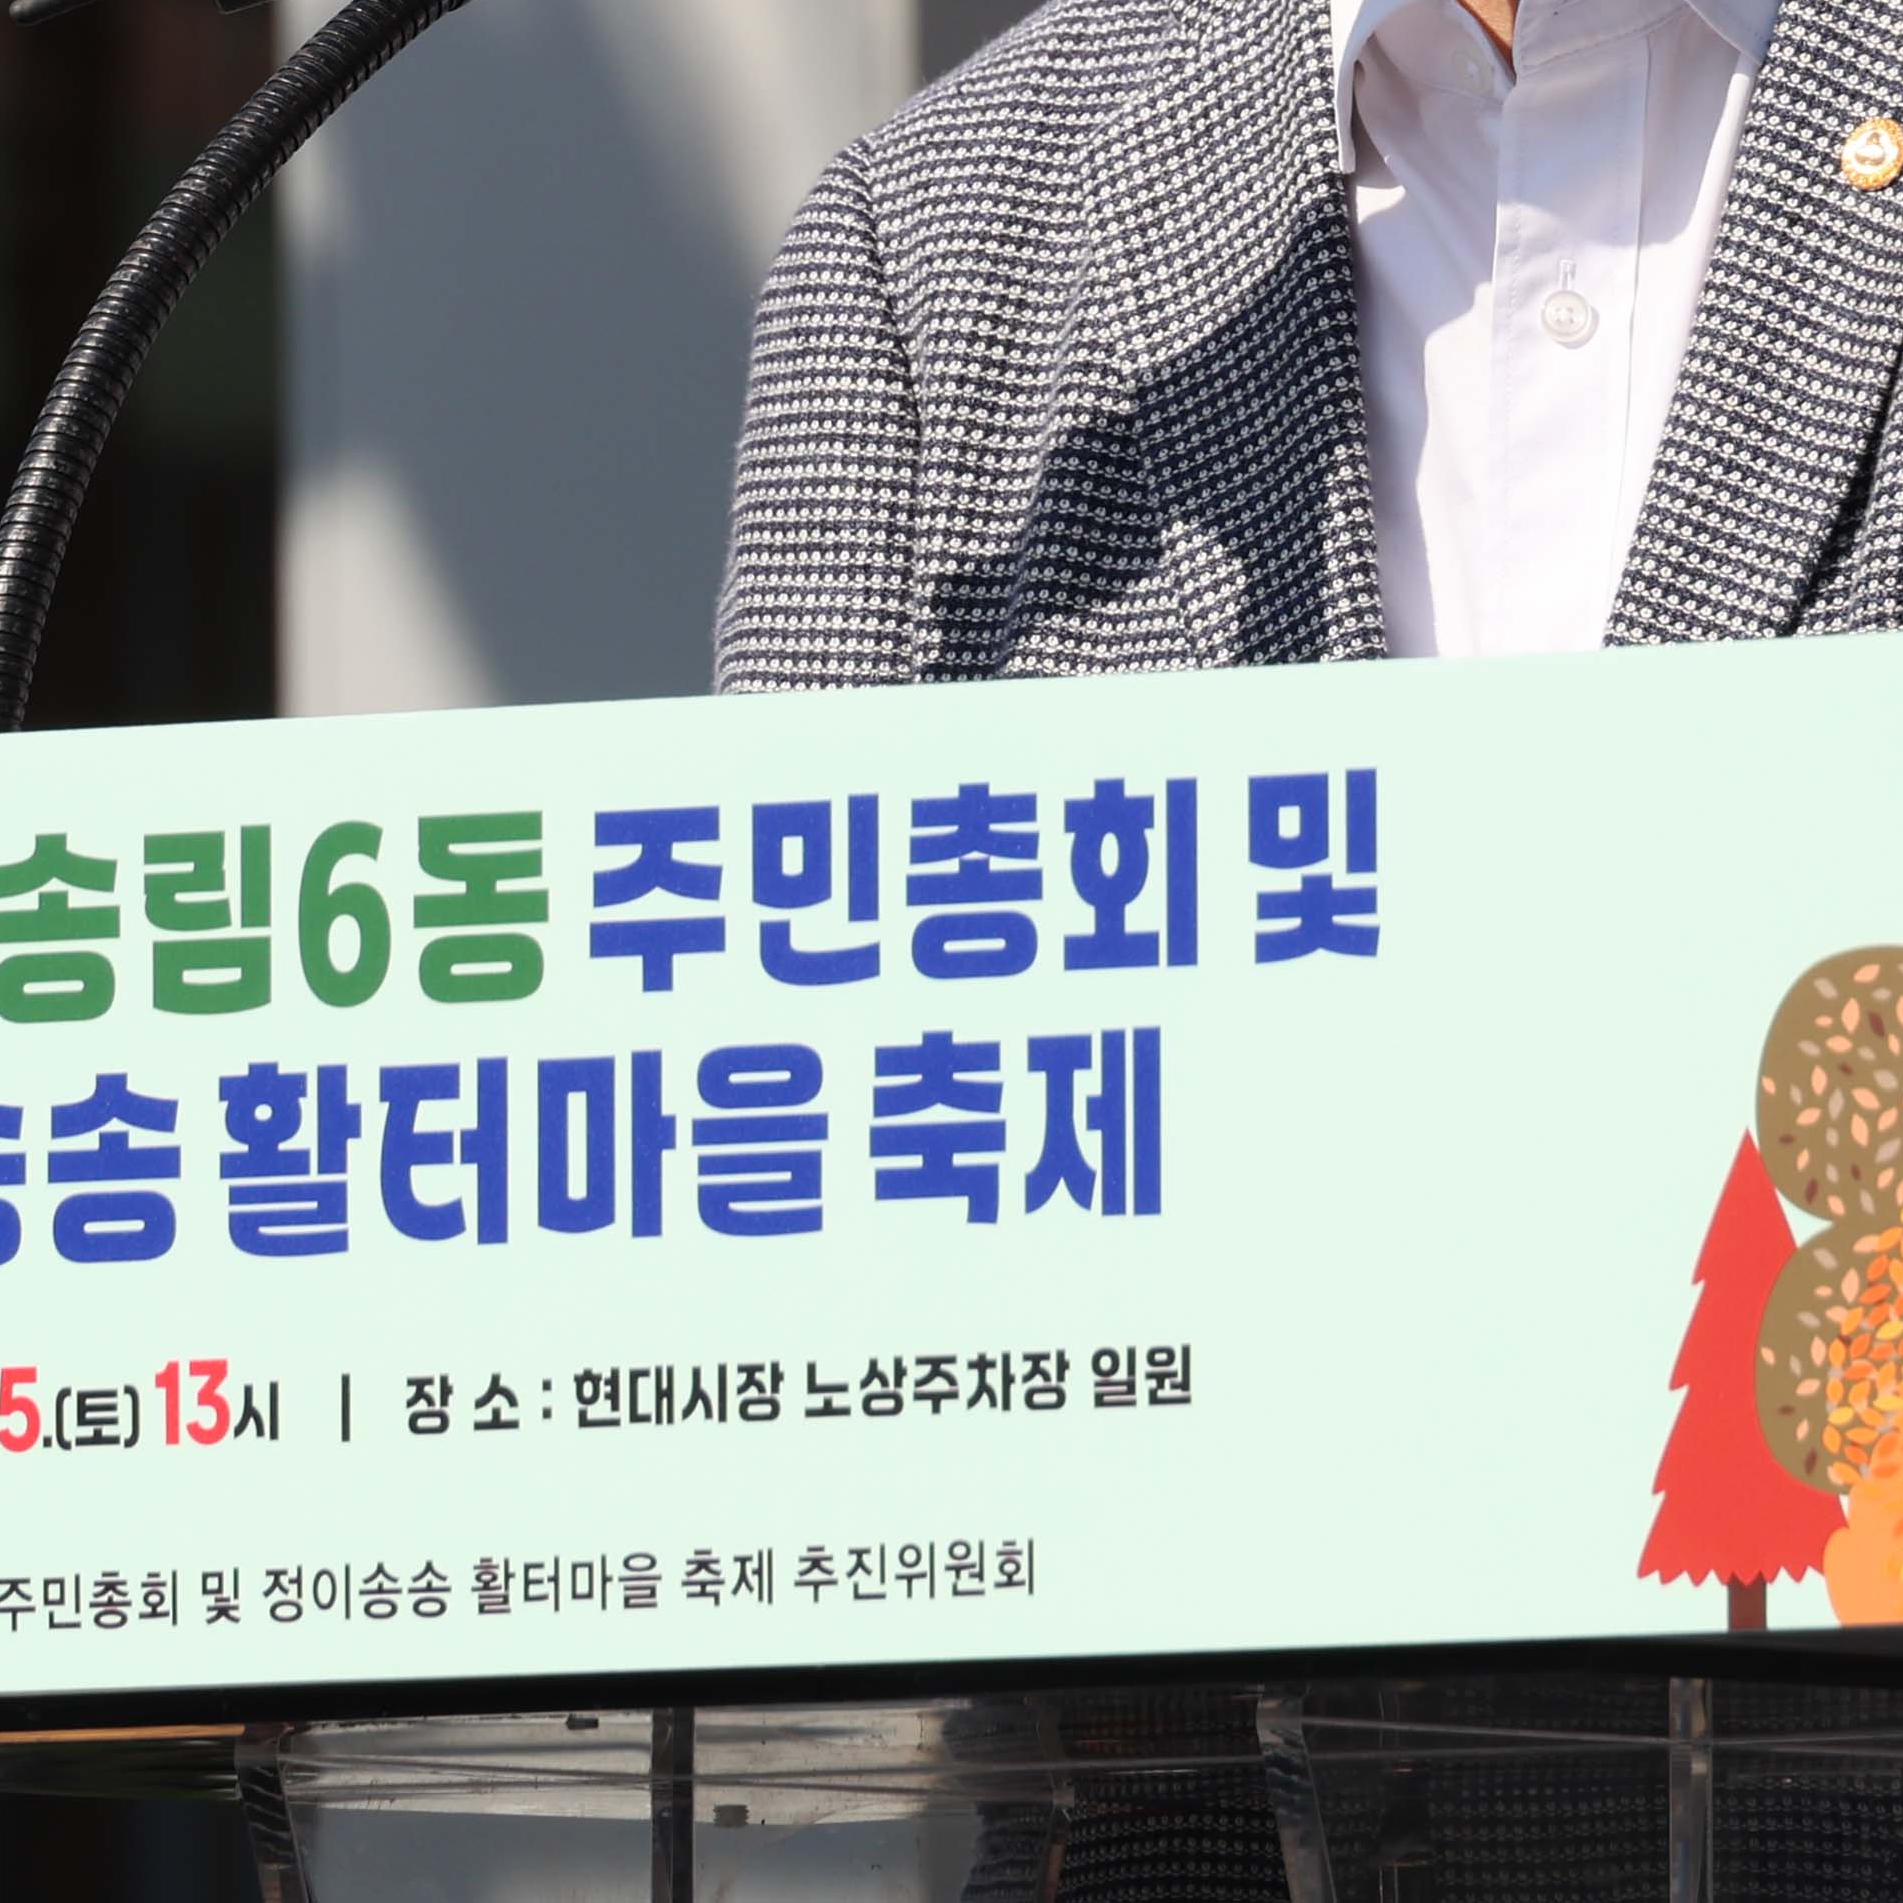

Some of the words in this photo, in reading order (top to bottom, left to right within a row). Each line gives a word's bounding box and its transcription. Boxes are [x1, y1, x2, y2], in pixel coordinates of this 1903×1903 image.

[588, 776, 1199, 994] 주민총회
[1247, 768, 1381, 965] 및
[218, 1043, 829, 1258] 활터마을
[868, 1026, 1162, 1225] 축제
[154, 1358, 280, 1446] 13시
[573, 1360, 785, 1429] 현대시장
[804, 1348, 1071, 1419] 노상주차장
[1090, 1343, 1192, 1409] 일원
[201, 1566, 242, 1626] 및
[262, 1559, 452, 1624] 정이송송
[470, 1552, 663, 1616] 활터마을
[680, 1547, 774, 1607] 축제
[793, 1538, 1035, 1604] 추진위원회
